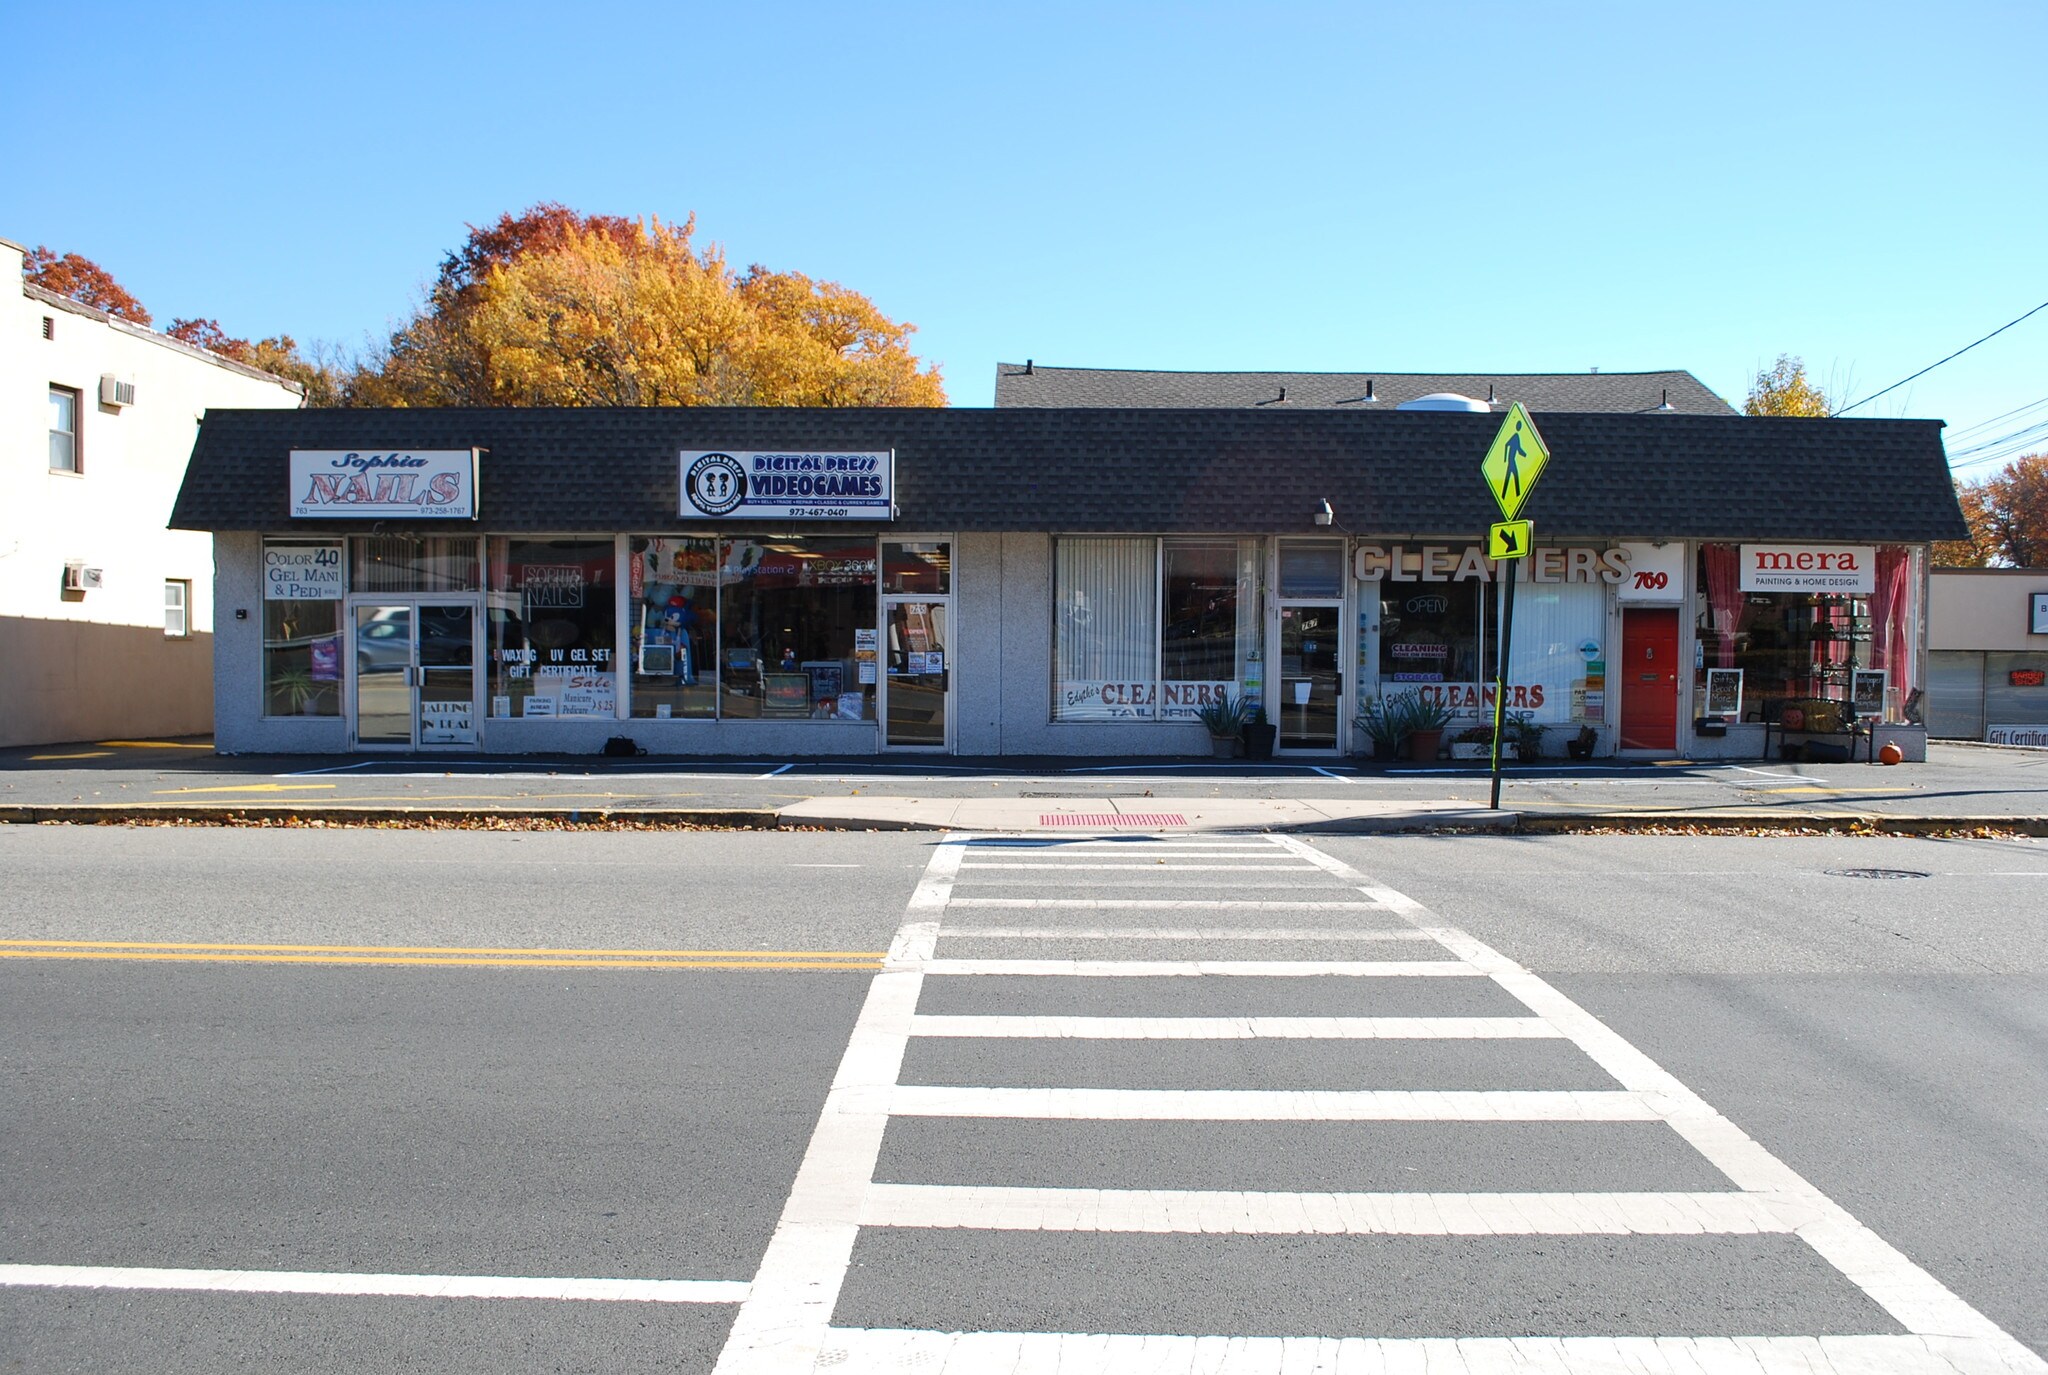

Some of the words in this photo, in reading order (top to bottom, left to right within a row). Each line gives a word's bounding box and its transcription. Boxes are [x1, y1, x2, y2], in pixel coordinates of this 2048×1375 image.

[331, 453, 429, 473] Sophia
[690, 456, 721, 476] DIGITAL
[754, 455, 822, 472] DIGITAL
[301, 472, 460, 505] NAILS
[750, 475, 882, 496] VIDEOGAMES
[789, 508, 848, 517] 973-467-0401
[265, 551, 312, 566] COLOR
[1755, 552, 1859, 571] mera
[269, 568, 299, 582] GEL
[304, 568, 339, 582] MANI
[733, 565, 784, 577] PlayStation
[787, 564, 795, 574] 2
[1633, 571, 1668, 590] 769
[1755, 577, 1792, 585] PAINTING
[1802, 578, 1827, 586] HOME
[1828, 578, 1859, 586] DESIGN
[275, 585, 285, 596] &
[289, 584, 322, 598] PEDI
[527, 585, 579, 606] NAILS
[1406, 599, 1447, 613] OPEN
[550, 648, 564, 661] UV
[570, 648, 588, 661] GEL
[592, 648, 610, 661] SET
[1392, 644, 1447, 652] CLEANING
[509, 665, 531, 678] GIFT
[540, 665, 598, 678] CERTIFICATE
[1394, 673, 1443, 681] STORAGE
[568, 676, 610, 689] Sale
[563, 692, 592, 703] Manicure
[1101, 684, 1226, 705] CLEANERS
[562, 705, 589, 715] Pedicure
[1990, 730, 2007, 744] Gift
[2010, 730, 2048, 746] Certifica
